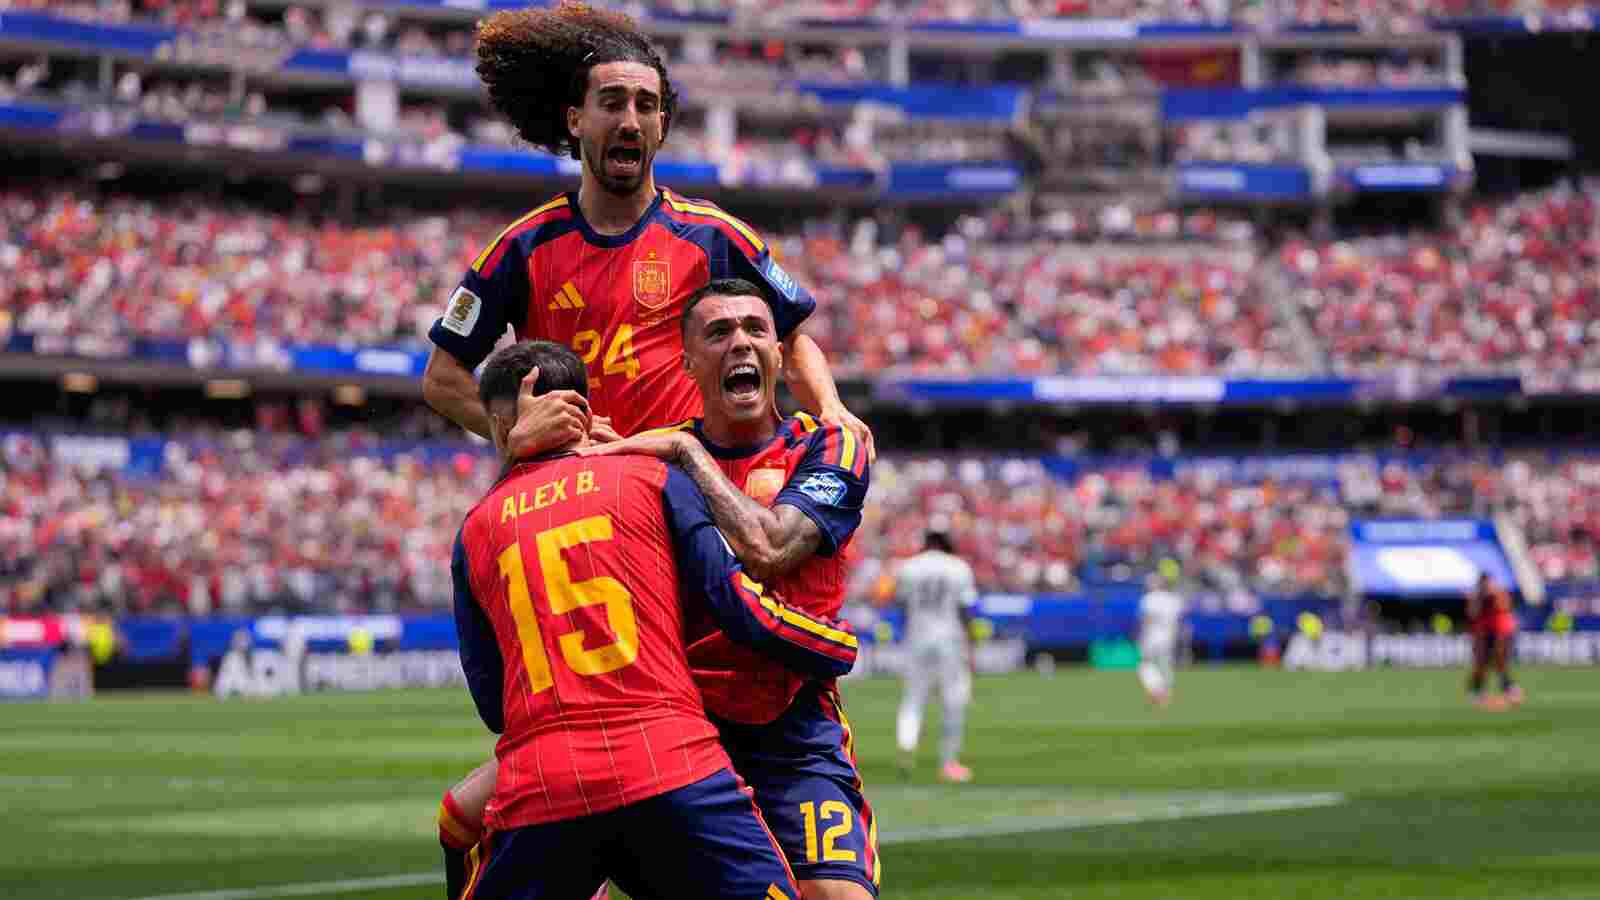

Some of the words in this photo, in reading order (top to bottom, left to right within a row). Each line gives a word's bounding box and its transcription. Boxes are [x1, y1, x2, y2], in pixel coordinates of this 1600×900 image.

[501, 476, 568, 523] ALEX
[576, 470, 601, 496] B.
[497, 514, 640, 694] 15
[799, 799, 857, 863] 12
